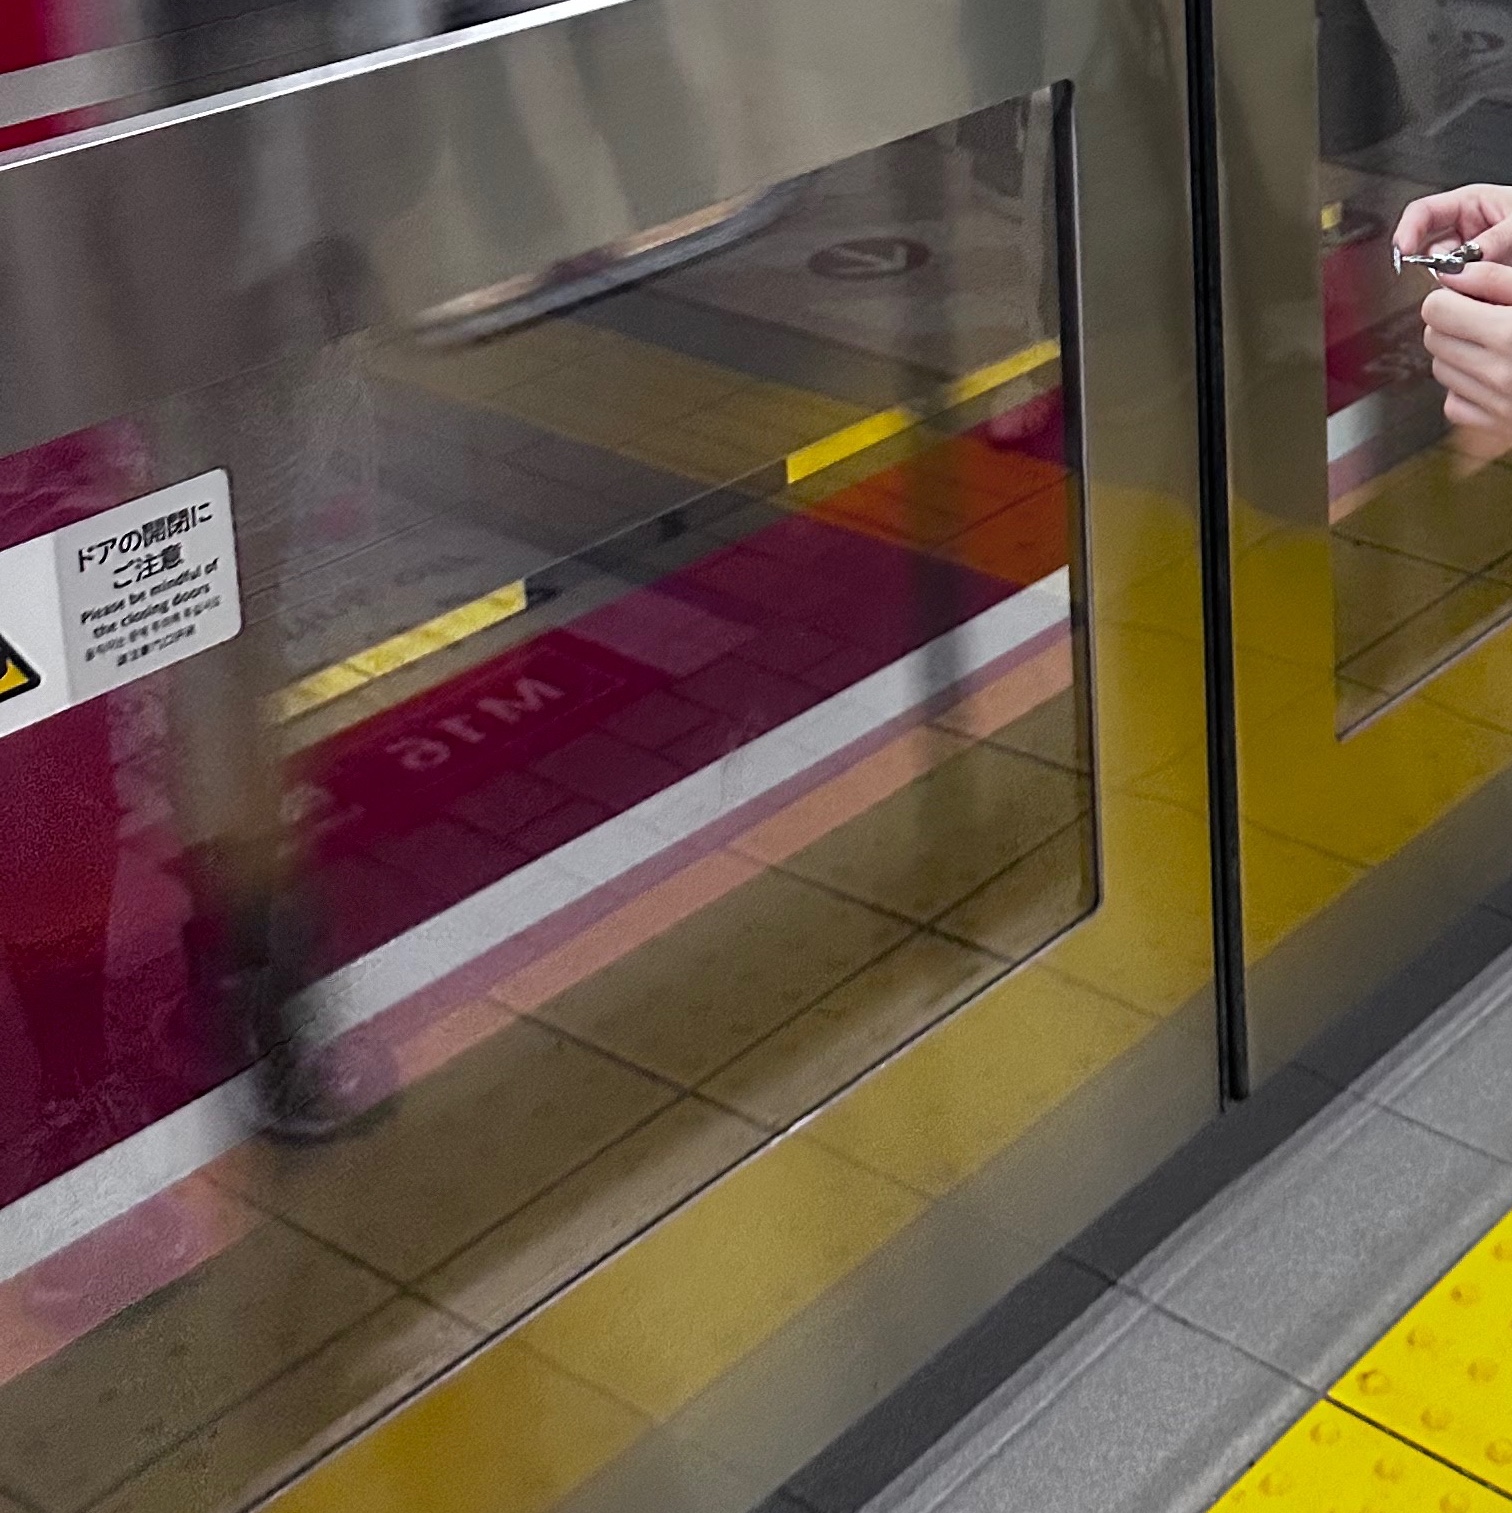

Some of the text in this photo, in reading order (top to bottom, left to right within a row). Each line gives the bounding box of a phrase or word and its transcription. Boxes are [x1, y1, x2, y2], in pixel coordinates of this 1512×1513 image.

[78, 502, 213, 572] ドアの開閉に
[113, 542, 184, 589] ご注意
[93, 621, 120, 639] the
